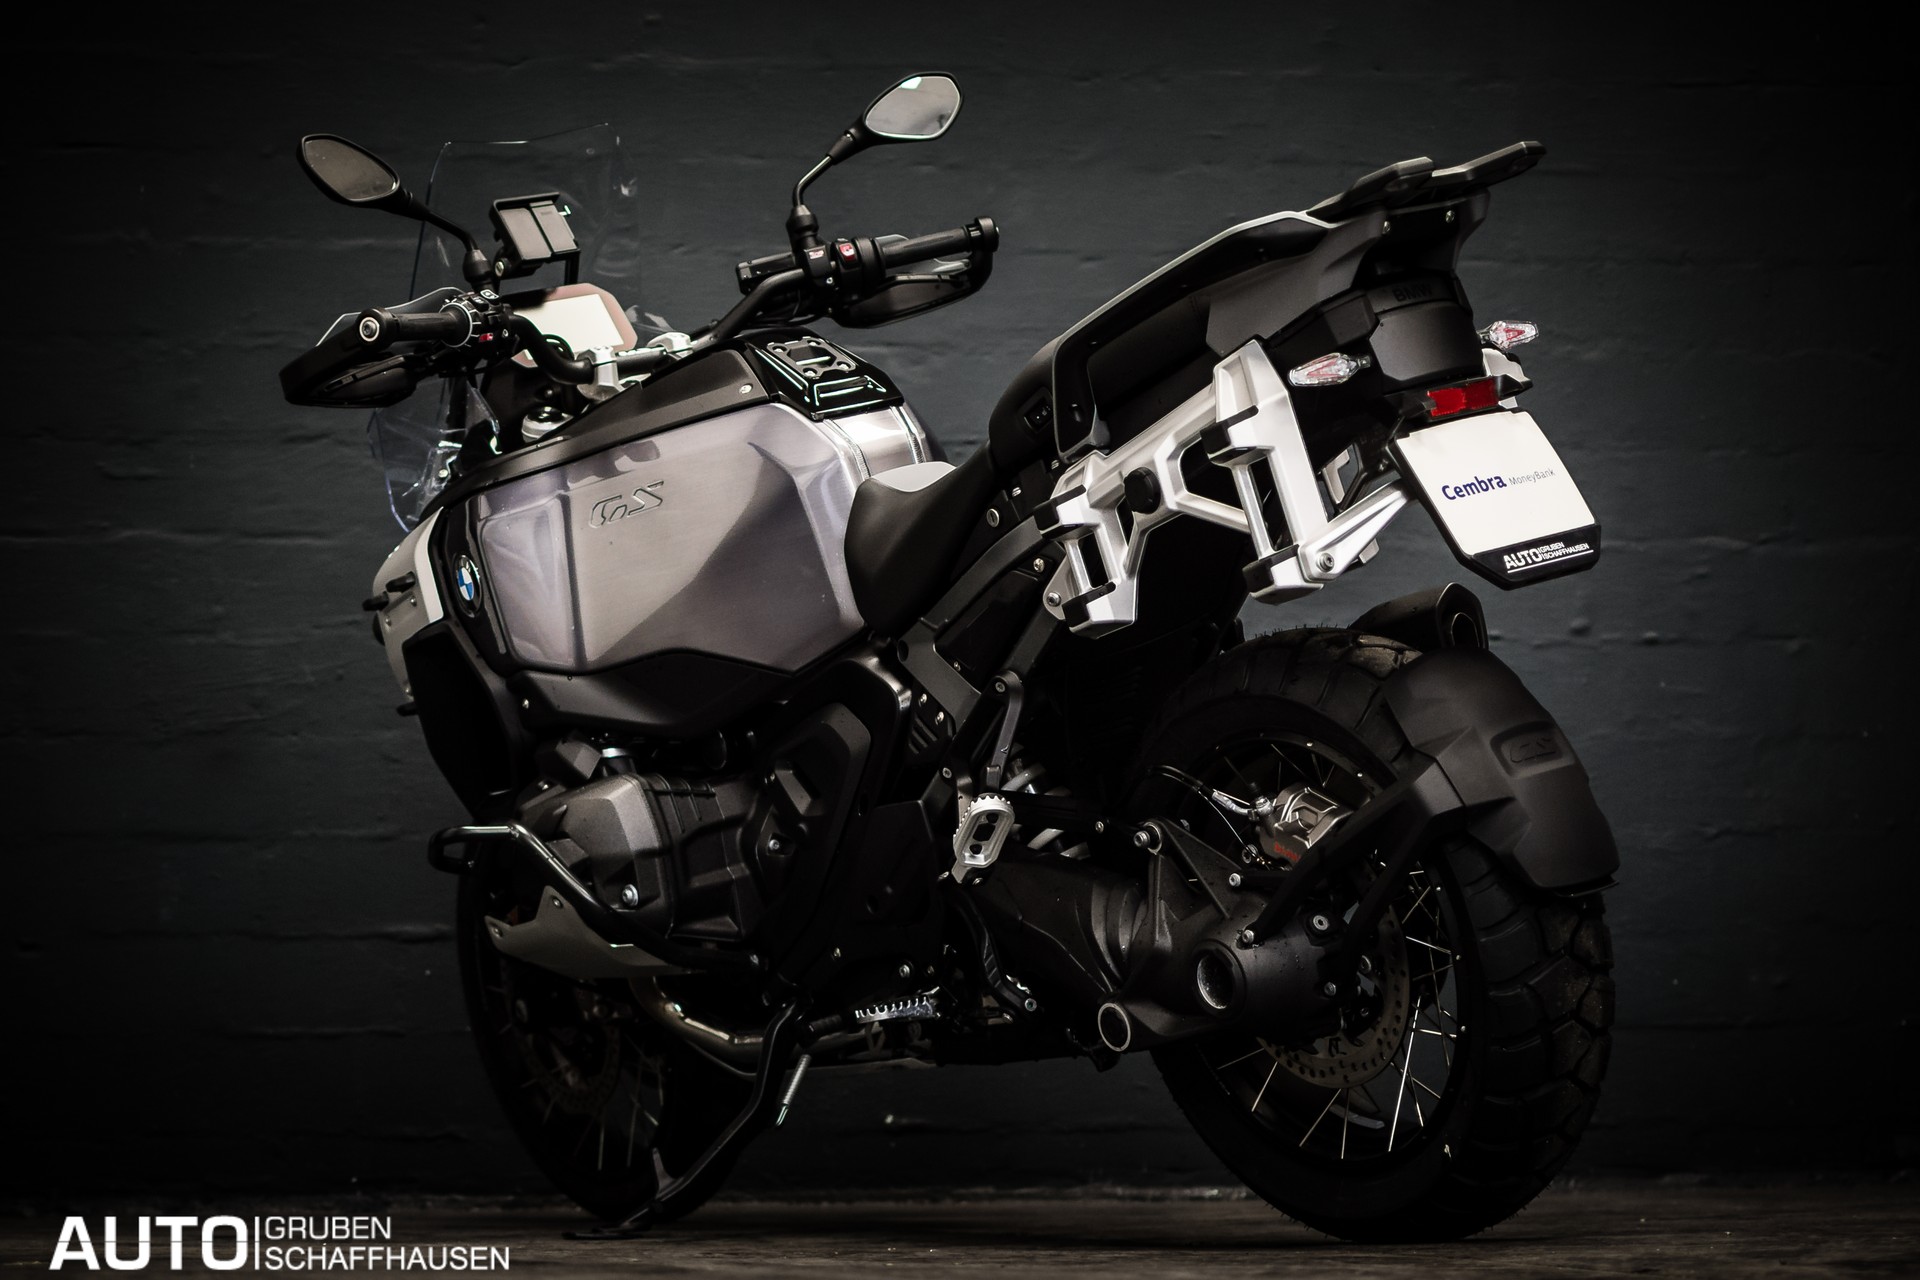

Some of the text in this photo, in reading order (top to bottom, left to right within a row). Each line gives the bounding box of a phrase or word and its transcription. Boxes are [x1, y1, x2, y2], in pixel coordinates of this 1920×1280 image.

[1392, 284, 1432, 301] BMW
[1442, 468, 1556, 500] Cembra MoneyBank
[589, 481, 664, 528] GS
[1540, 542, 1565, 554] GRUBEN
[1544, 543, 1590, 560] SCHAFFHAUSEN
[1503, 548, 1542, 569] AUTO
